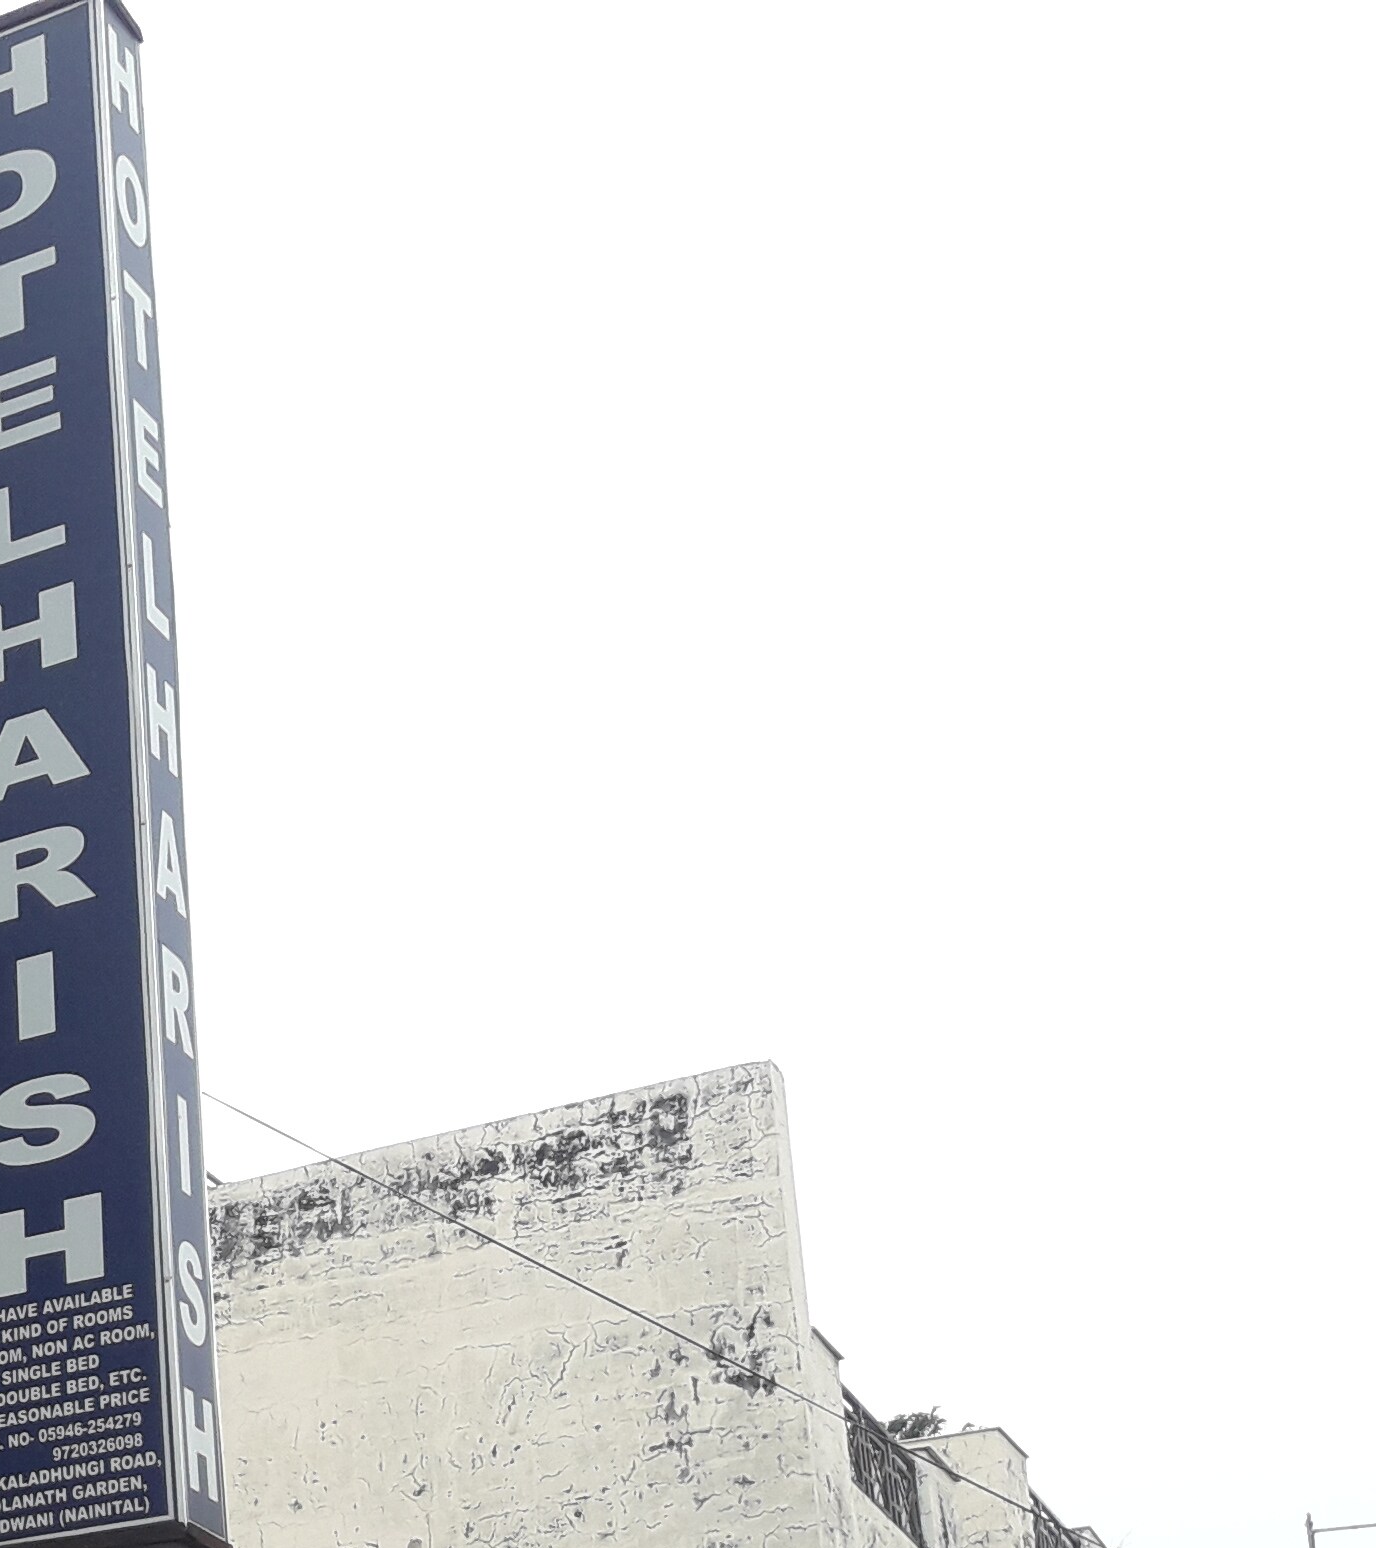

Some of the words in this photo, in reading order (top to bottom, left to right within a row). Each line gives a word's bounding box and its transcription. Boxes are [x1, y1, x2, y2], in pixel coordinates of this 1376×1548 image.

[43, 1284, 134, 1315] AVAILABLE
[1, 1323, 41, 1344] KIND
[47, 1317, 68, 1335] OF
[73, 1305, 133, 1329] ROOMS
[32, 1340, 67, 1360] NON
[73, 1333, 95, 1351] AC
[100, 1323, 155, 1347] ROOM,
[1, 1362, 61, 1386] SINGLE
[66, 1354, 99, 1374] BED
[66, 1375, 104, 1395] BED,
[109, 1368, 147, 1387] ETC.
[100, 1387, 150, 1410] PRICE
[8, 1431, 34, 1448] NO-
[38, 1412, 142, 1443] 05946-254279
[52, 1433, 143, 1461] 9720326098
[110, 1451, 162, 1475] ROAD,
[72, 1475, 147, 1501] GARDEN,
[59, 1496, 150, 1528] (NAINITAL)
